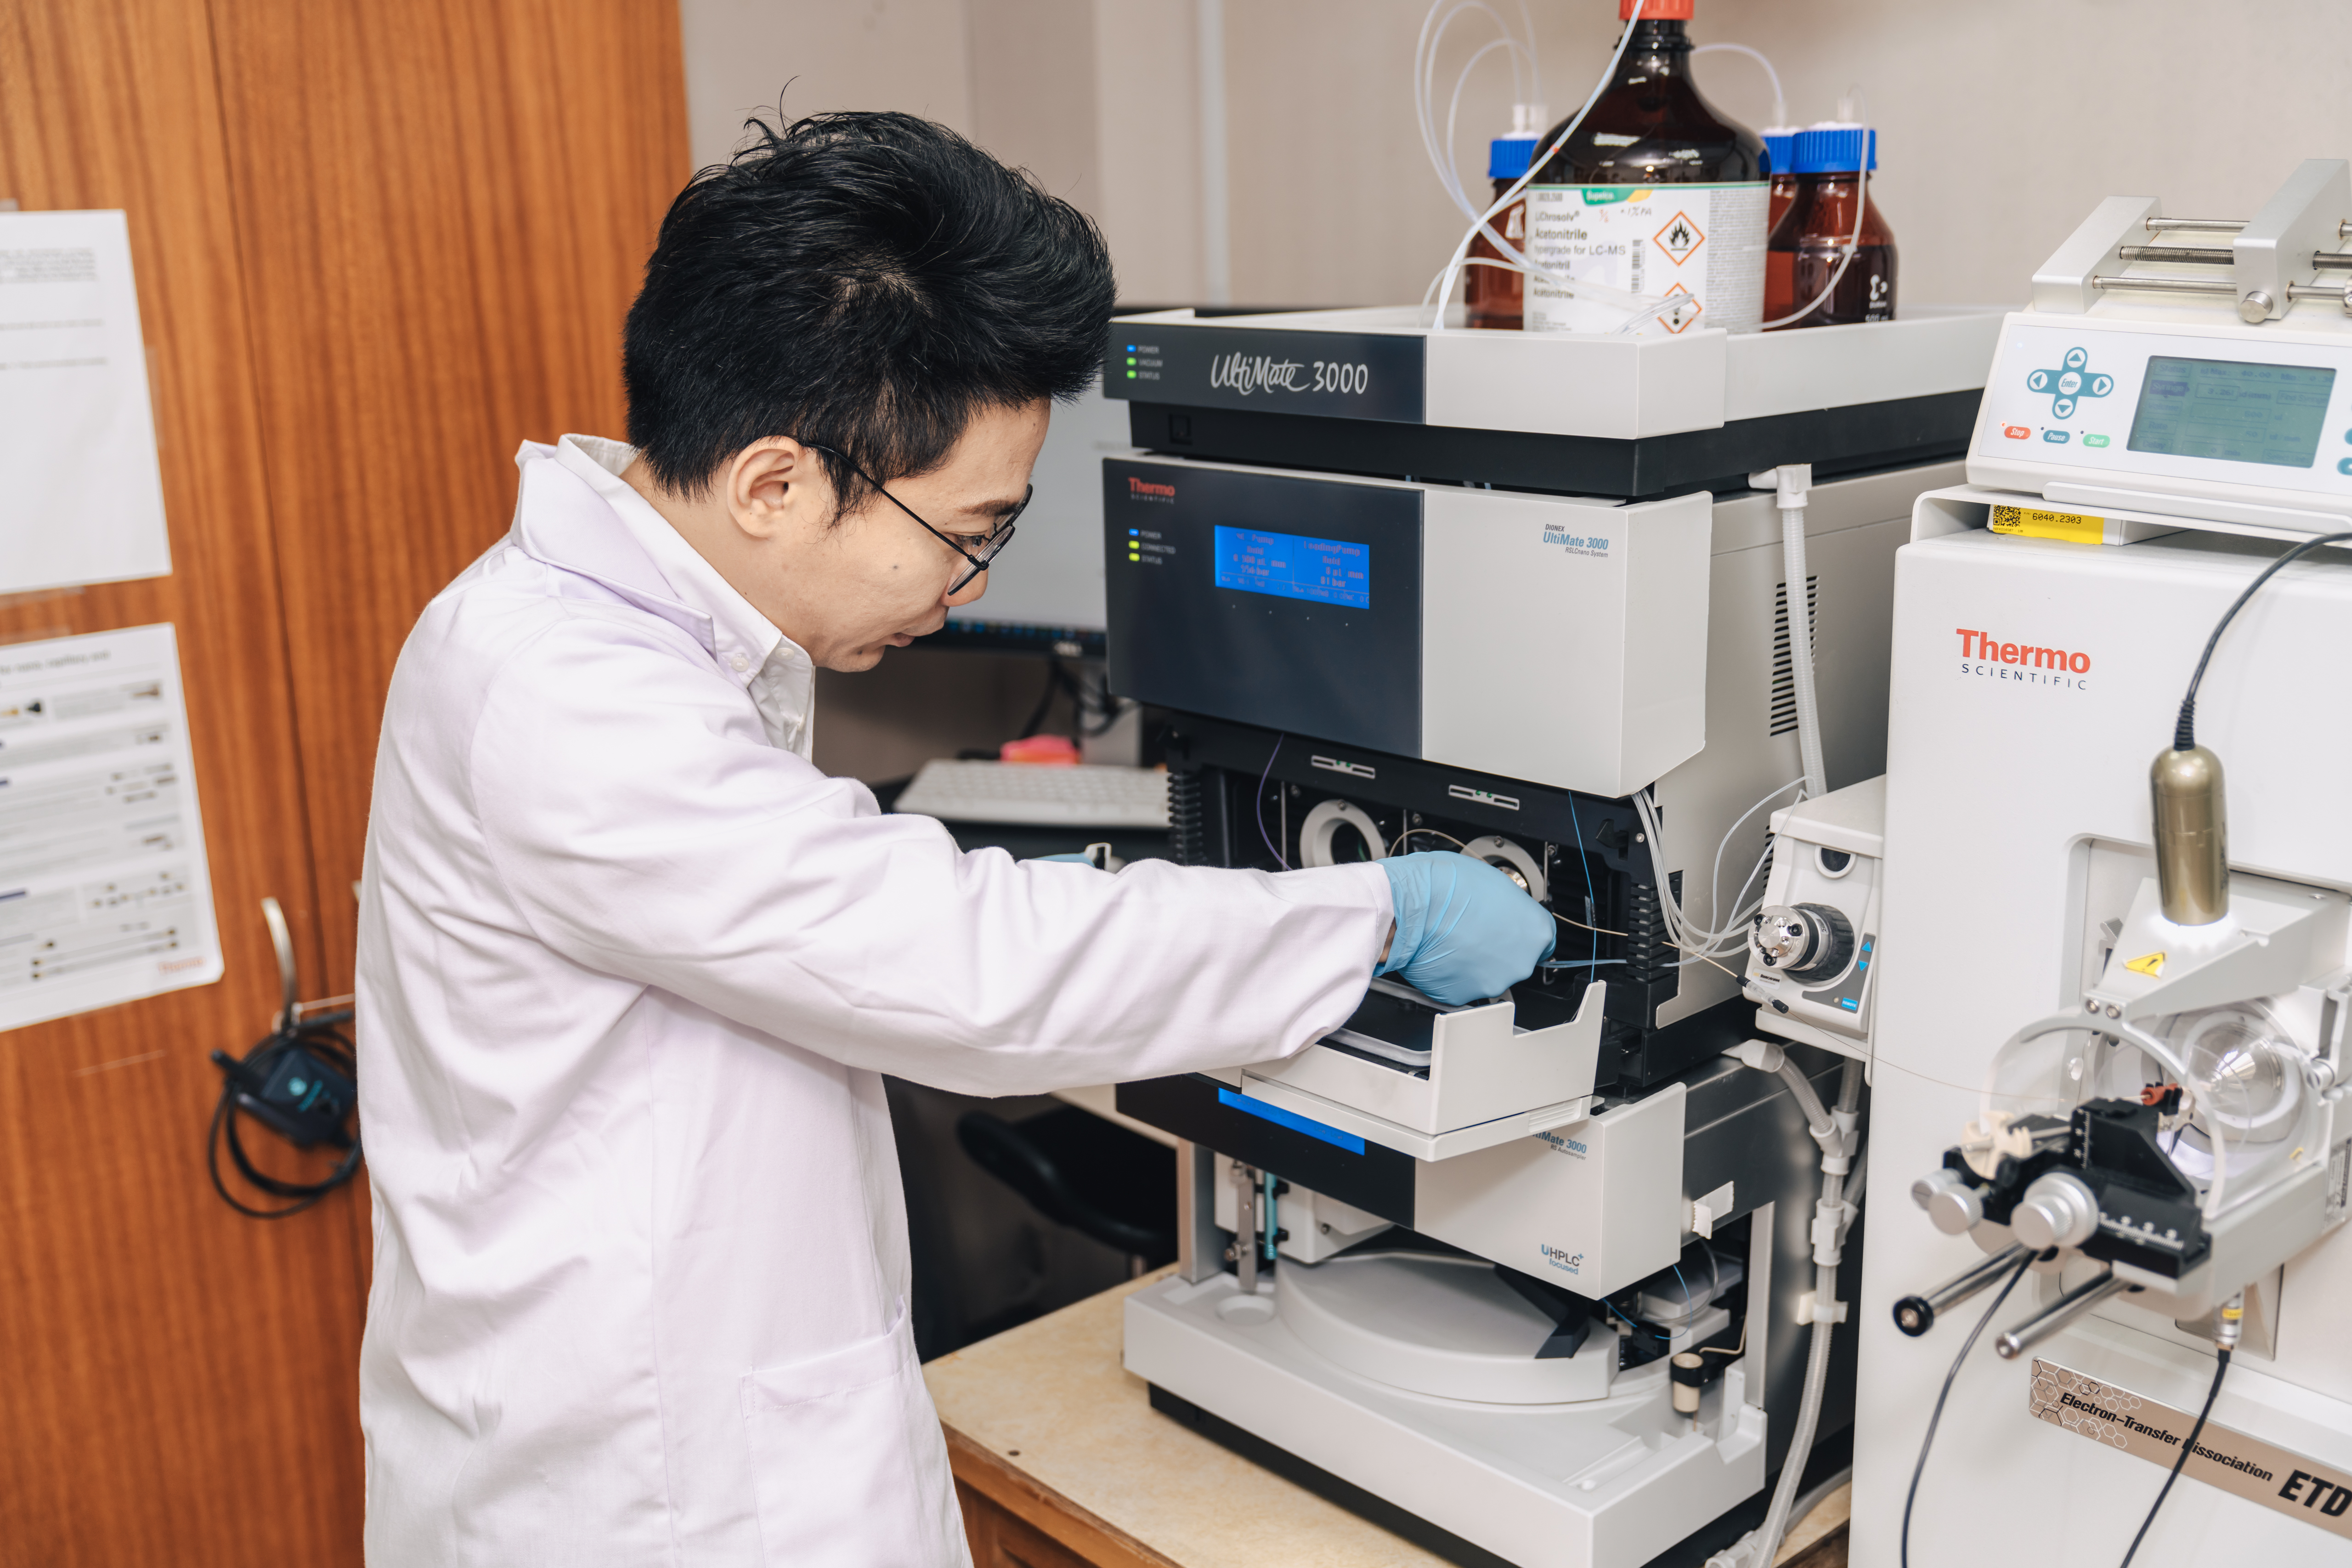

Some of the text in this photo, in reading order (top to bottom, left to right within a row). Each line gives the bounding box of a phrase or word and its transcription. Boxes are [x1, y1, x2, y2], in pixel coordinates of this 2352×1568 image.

[1534, 228, 1588, 241] Acetonitrile
[1574, 245, 1586, 255] for
[1589, 245, 1626, 255] LC-MS
[1138, 345, 1160, 354] POWER
[1138, 358, 1164, 368] VACUUM
[2159, 363, 2187, 374] Status
[1138, 371, 1160, 380] STATUS
[1210, 351, 1368, 396] UltiMate 3000
[2061, 379, 2078, 388] Enter
[2148, 421, 2168, 430] Rate
[2010, 428, 2025, 438] Stop
[2047, 432, 2066, 442] Pause
[2088, 436, 2105, 446] Start
[1128, 476, 1176, 497] Thermo
[1131, 493, 1175, 504] SCIENTIFIC
[2032, 513, 2081, 524] 6040.2303
[1545, 524, 1565, 532] DIONEX
[1140, 530, 1162, 540] POWER
[1543, 532, 1609, 550] UltiMate 3000
[1304, 540, 1361, 557] LoadingPump
[1565, 547, 1590, 555] RSLCnano
[1141, 555, 1163, 565] STATUS
[1323, 555, 1341, 566] Hold
[1256, 566, 1270, 577] bar
[1332, 577, 1346, 588] bar
[1956, 628, 2091, 674] Thermo
[1962, 664, 2086, 690] SCIENTIFIC
[1566, 1139, 1587, 1154] 3000
[1558, 1147, 1586, 1160] Autosampler
[1549, 1258, 1578, 1275] focused
[2060, 1392, 2181, 1446] Electron-Transfer
[2278, 1469, 2352, 1517] ETD
